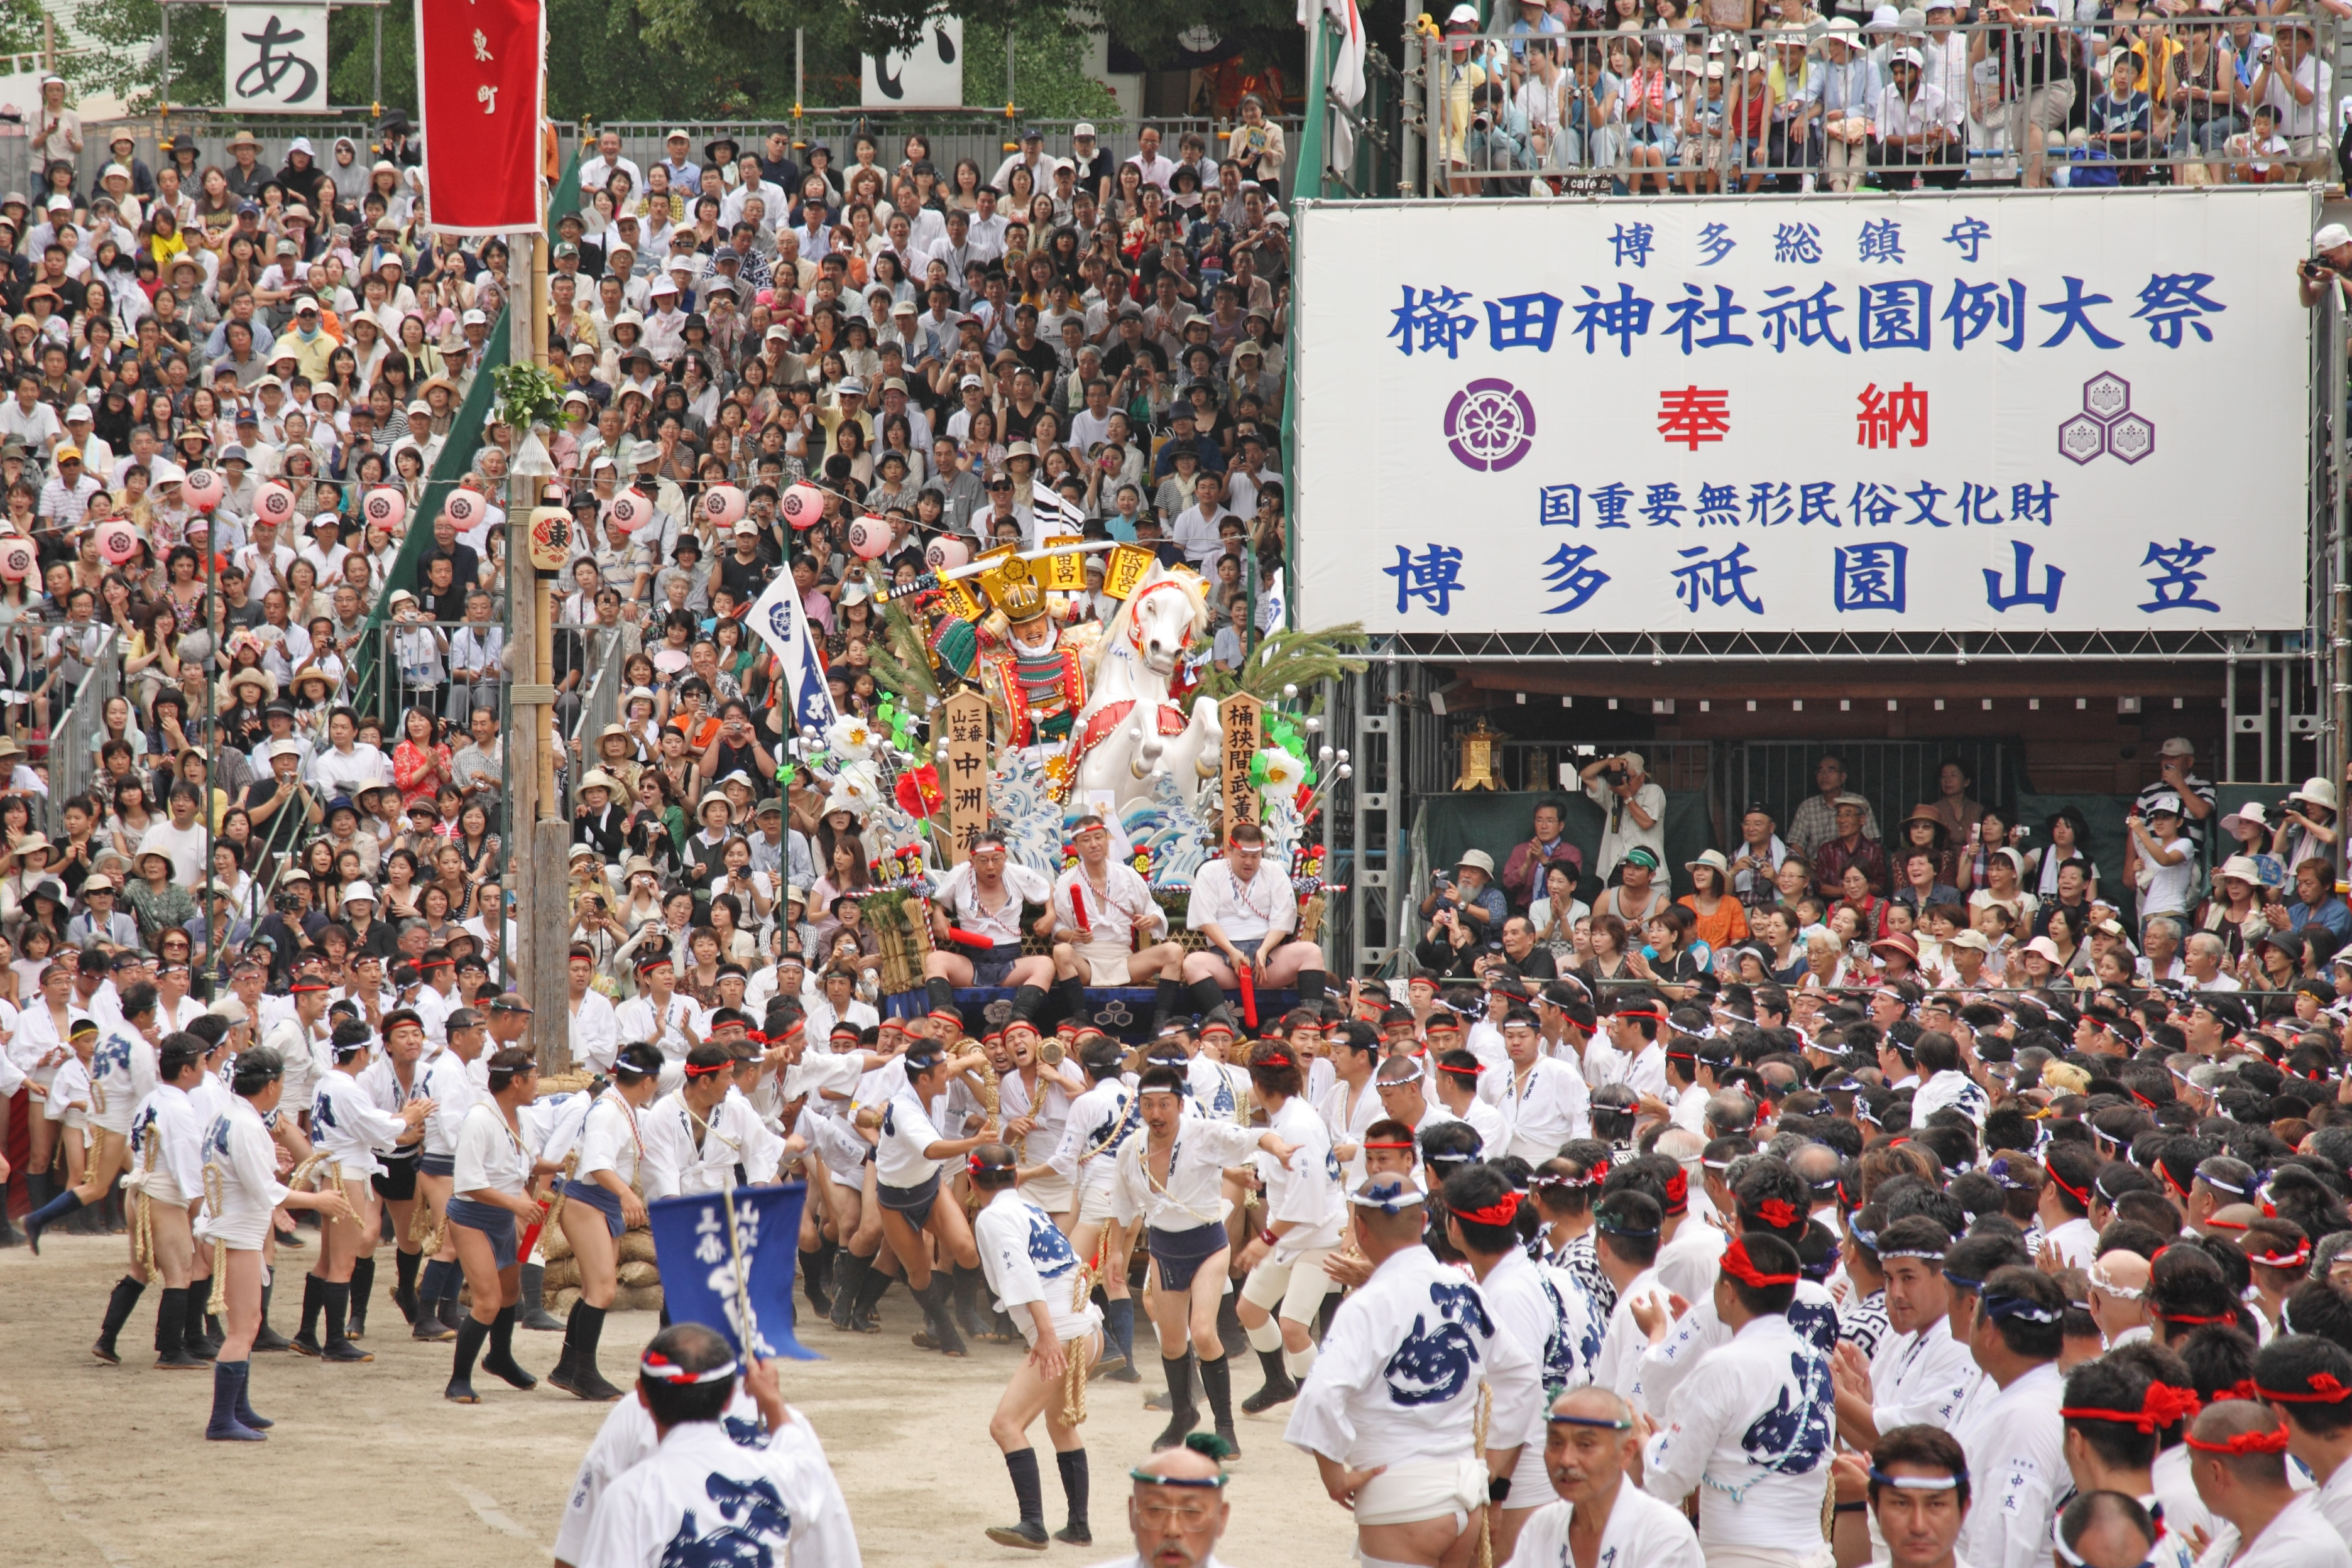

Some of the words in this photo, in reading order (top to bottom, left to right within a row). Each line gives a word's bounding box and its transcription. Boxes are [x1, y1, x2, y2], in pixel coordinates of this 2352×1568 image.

[235, 15, 318, 104] あ
[470, 0, 498, 114] 東町
[1607, 215, 1992, 269] 博多総鎮守
[1387, 272, 2228, 360] 櫛田神社祇園例大祭
[1656, 381, 1928, 452] 奉納
[545, 519, 569, 548] 東
[1540, 480, 2059, 530] 国重要無形民俗文化財
[1055, 542, 1076, 583] 田宮
[1384, 538, 2221, 616] 博多祇園山笠
[952, 709, 967, 743] 山笠
[968, 709, 983, 743] 三番
[1228, 704, 1255, 823] 桶狭間武薫
[953, 751, 983, 850] 中洲流
[2003, 1473, 2024, 1510] 中五
